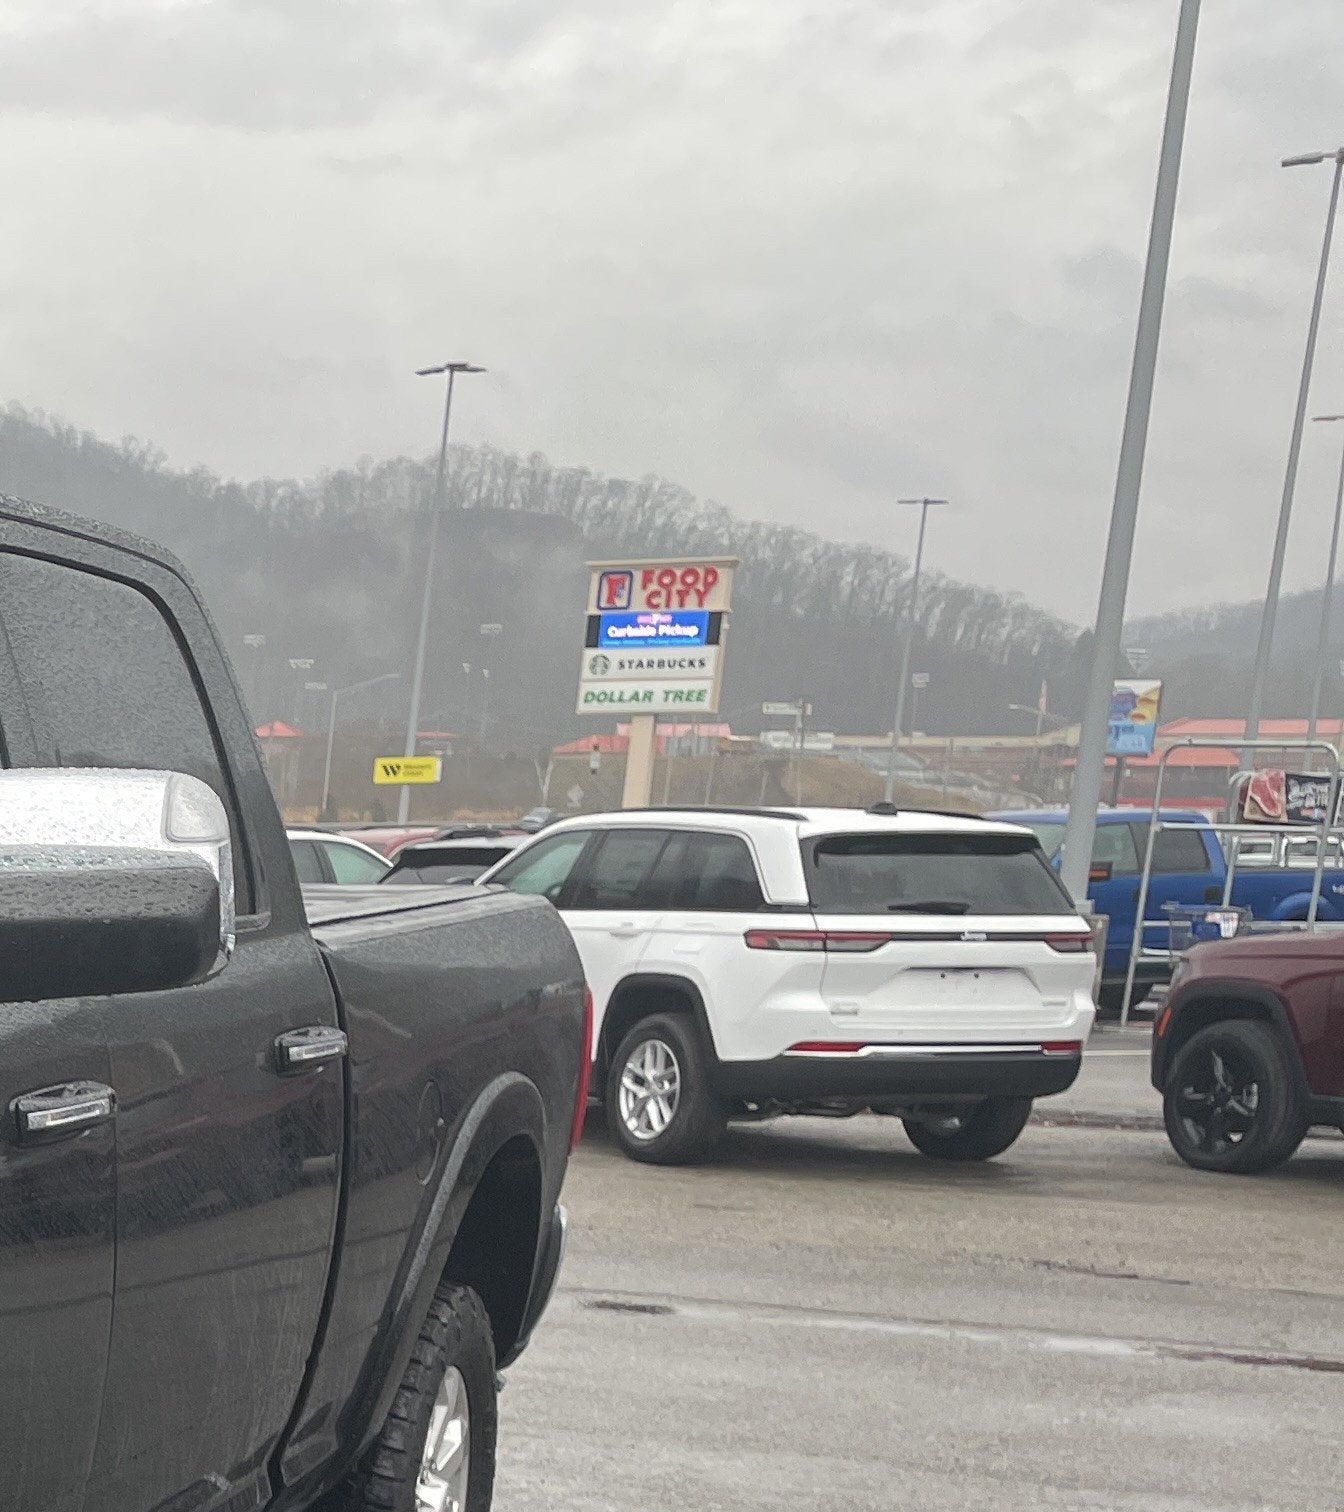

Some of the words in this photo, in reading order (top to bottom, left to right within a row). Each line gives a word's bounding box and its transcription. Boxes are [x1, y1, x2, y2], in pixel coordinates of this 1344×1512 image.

[640, 566, 719, 590] FOOD
[644, 588, 710, 610] CITY
[617, 657, 707, 671] STARBUCKS
[583, 689, 654, 705] DOLLAR
[663, 688, 708, 703] TREE
